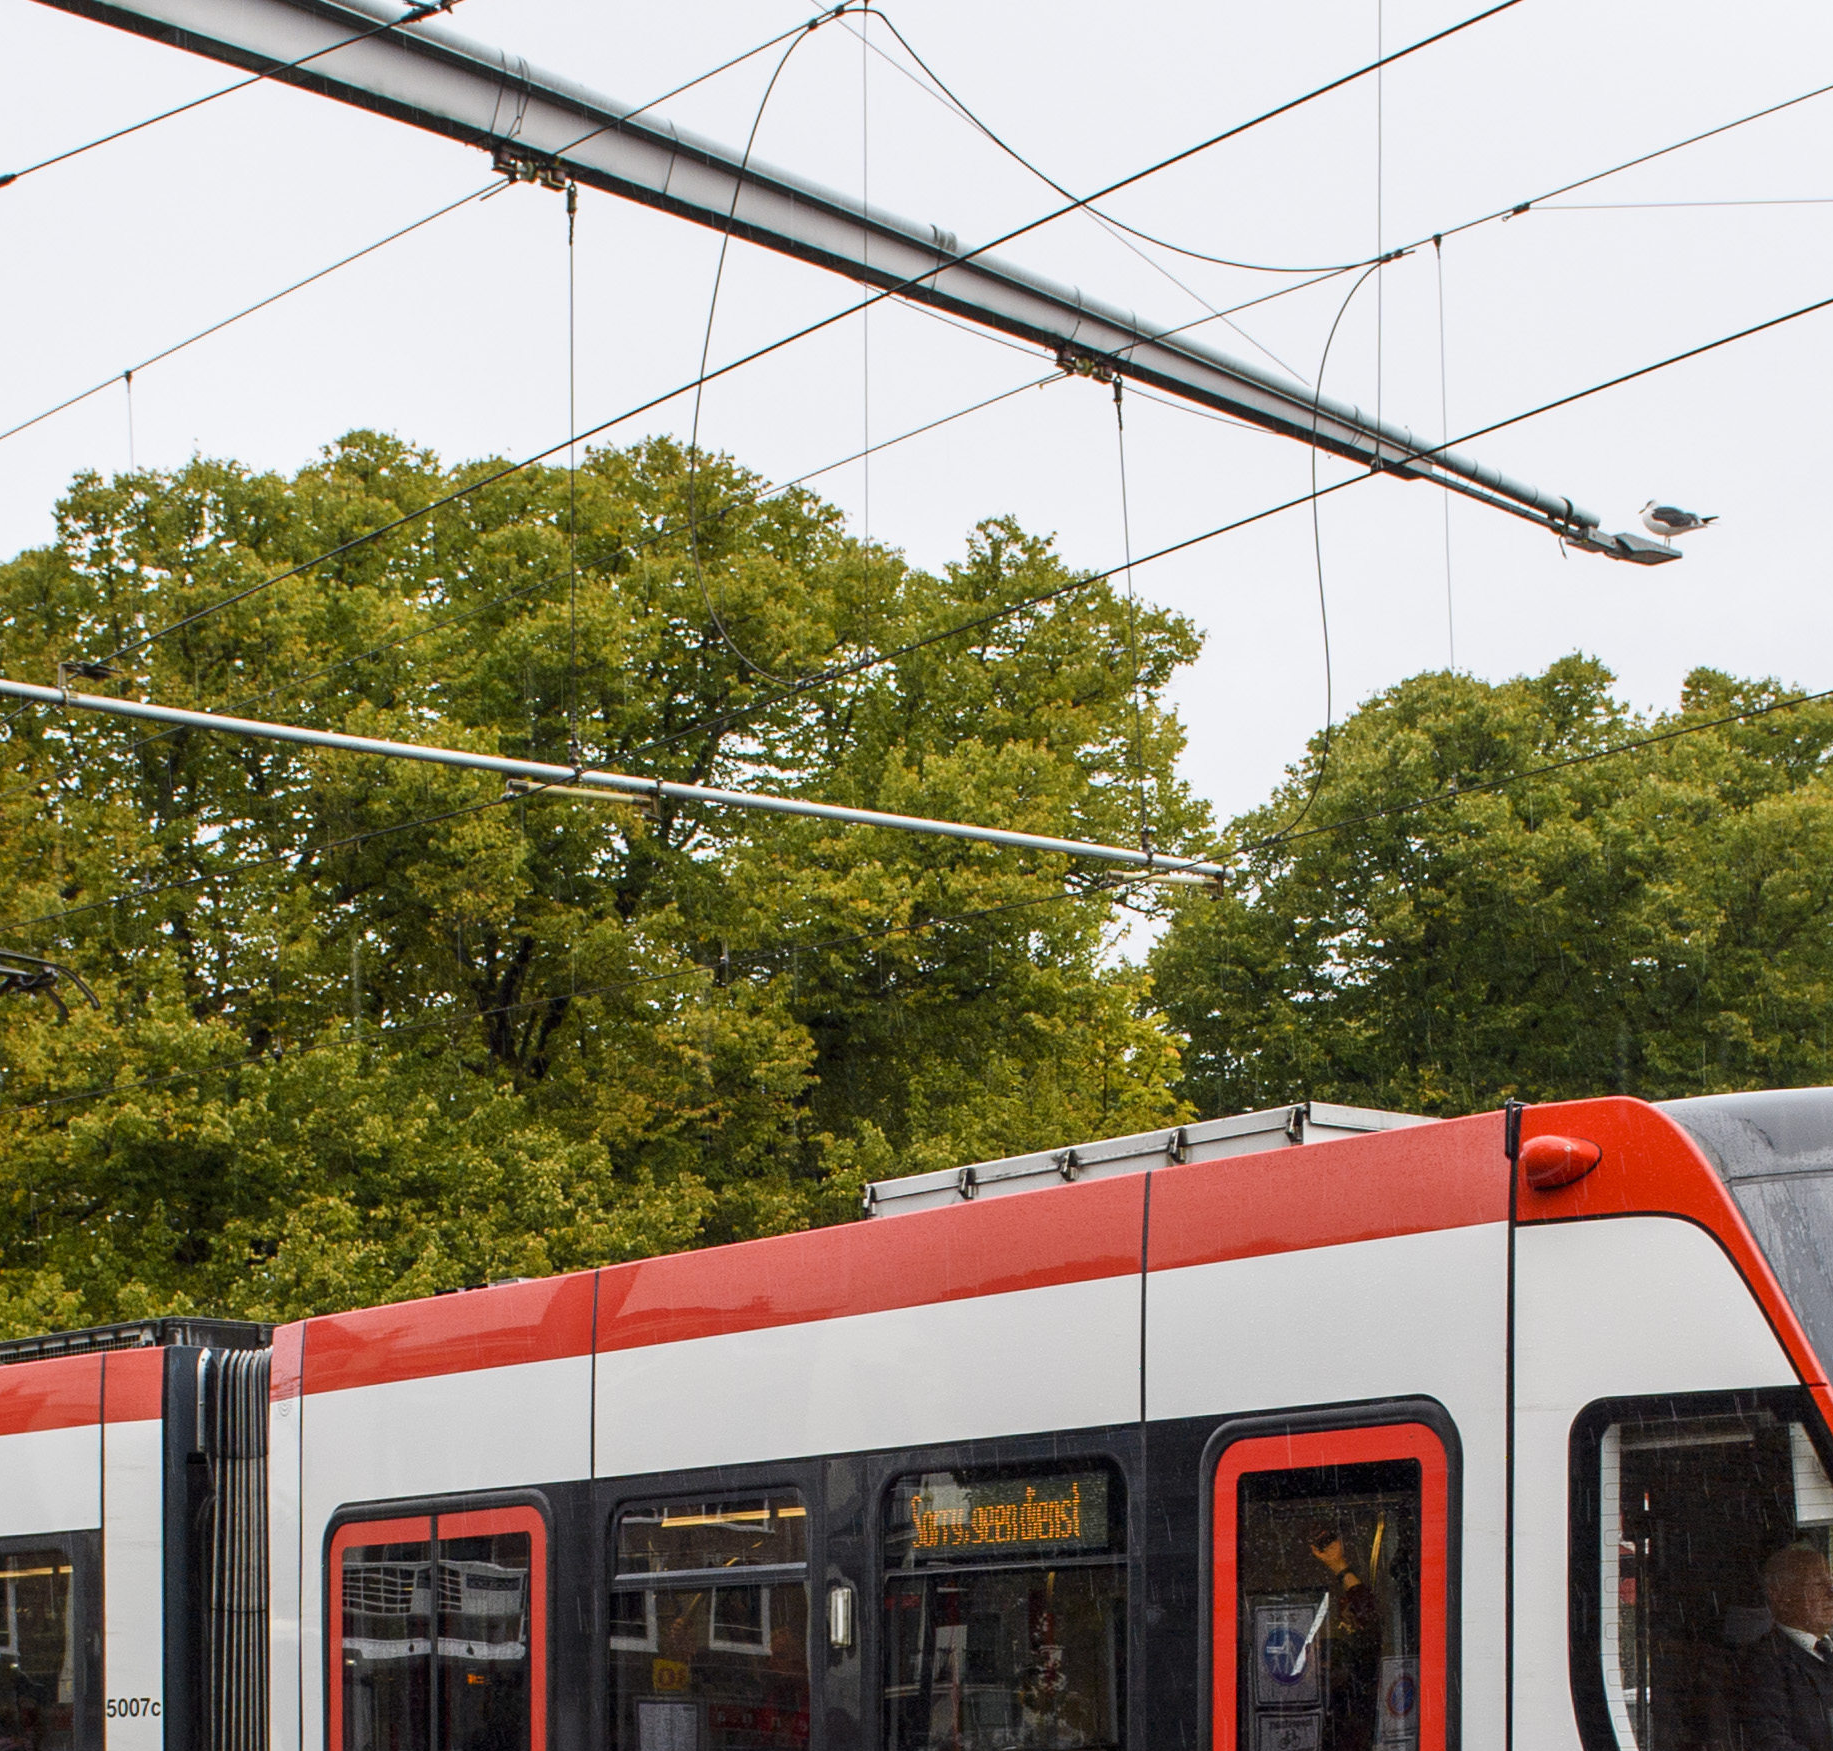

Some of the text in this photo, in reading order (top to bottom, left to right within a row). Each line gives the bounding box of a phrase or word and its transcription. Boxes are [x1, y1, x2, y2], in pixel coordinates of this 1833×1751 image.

[971, 1504, 1018, 1543] geen
[1019, 1482, 1080, 1541] dienst
[107, 1698, 161, 1718] 5007c
